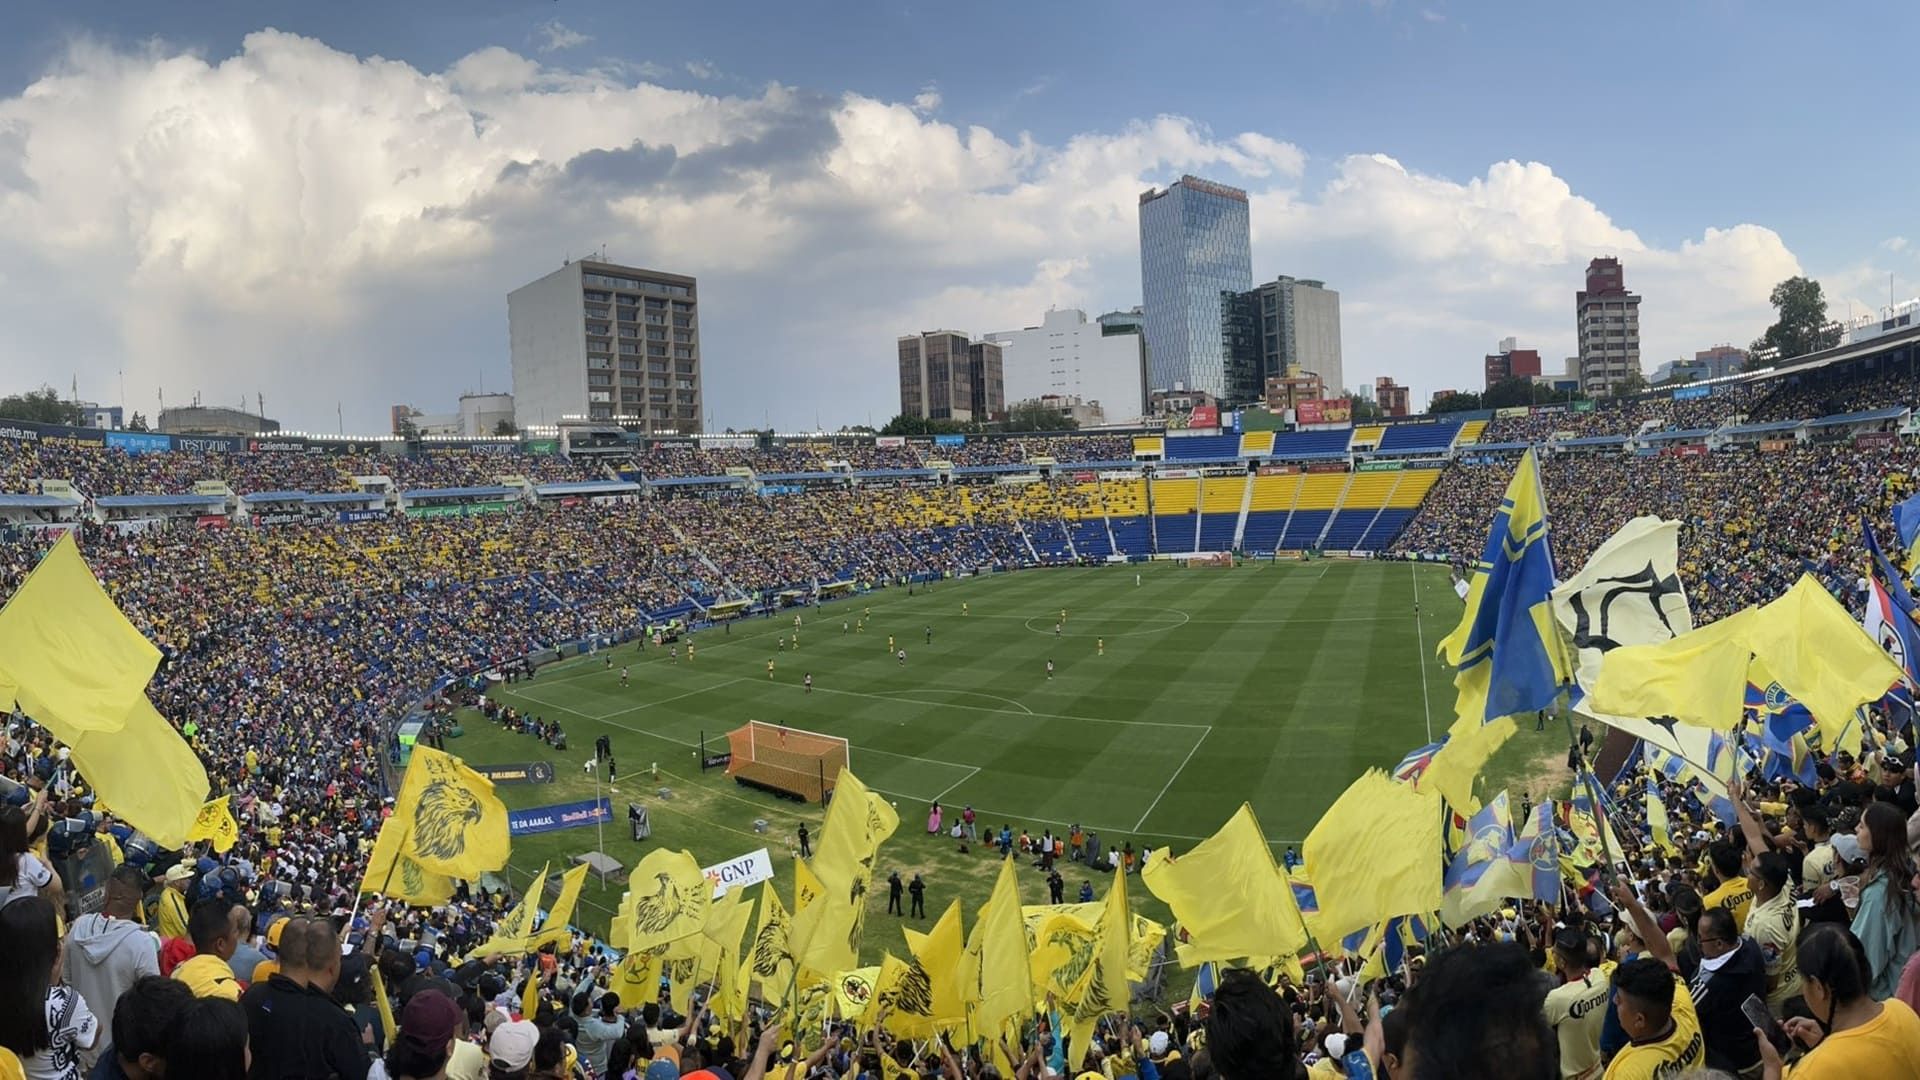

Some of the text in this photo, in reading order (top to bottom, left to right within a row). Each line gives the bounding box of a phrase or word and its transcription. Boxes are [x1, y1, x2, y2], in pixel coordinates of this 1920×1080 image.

[259, 441, 304, 451] caliente.mx
[511, 821, 519, 829] TE
[519, 820, 528, 828] DA
[721, 858, 754, 883] GNP
[1721, 891, 1754, 911] Coro
